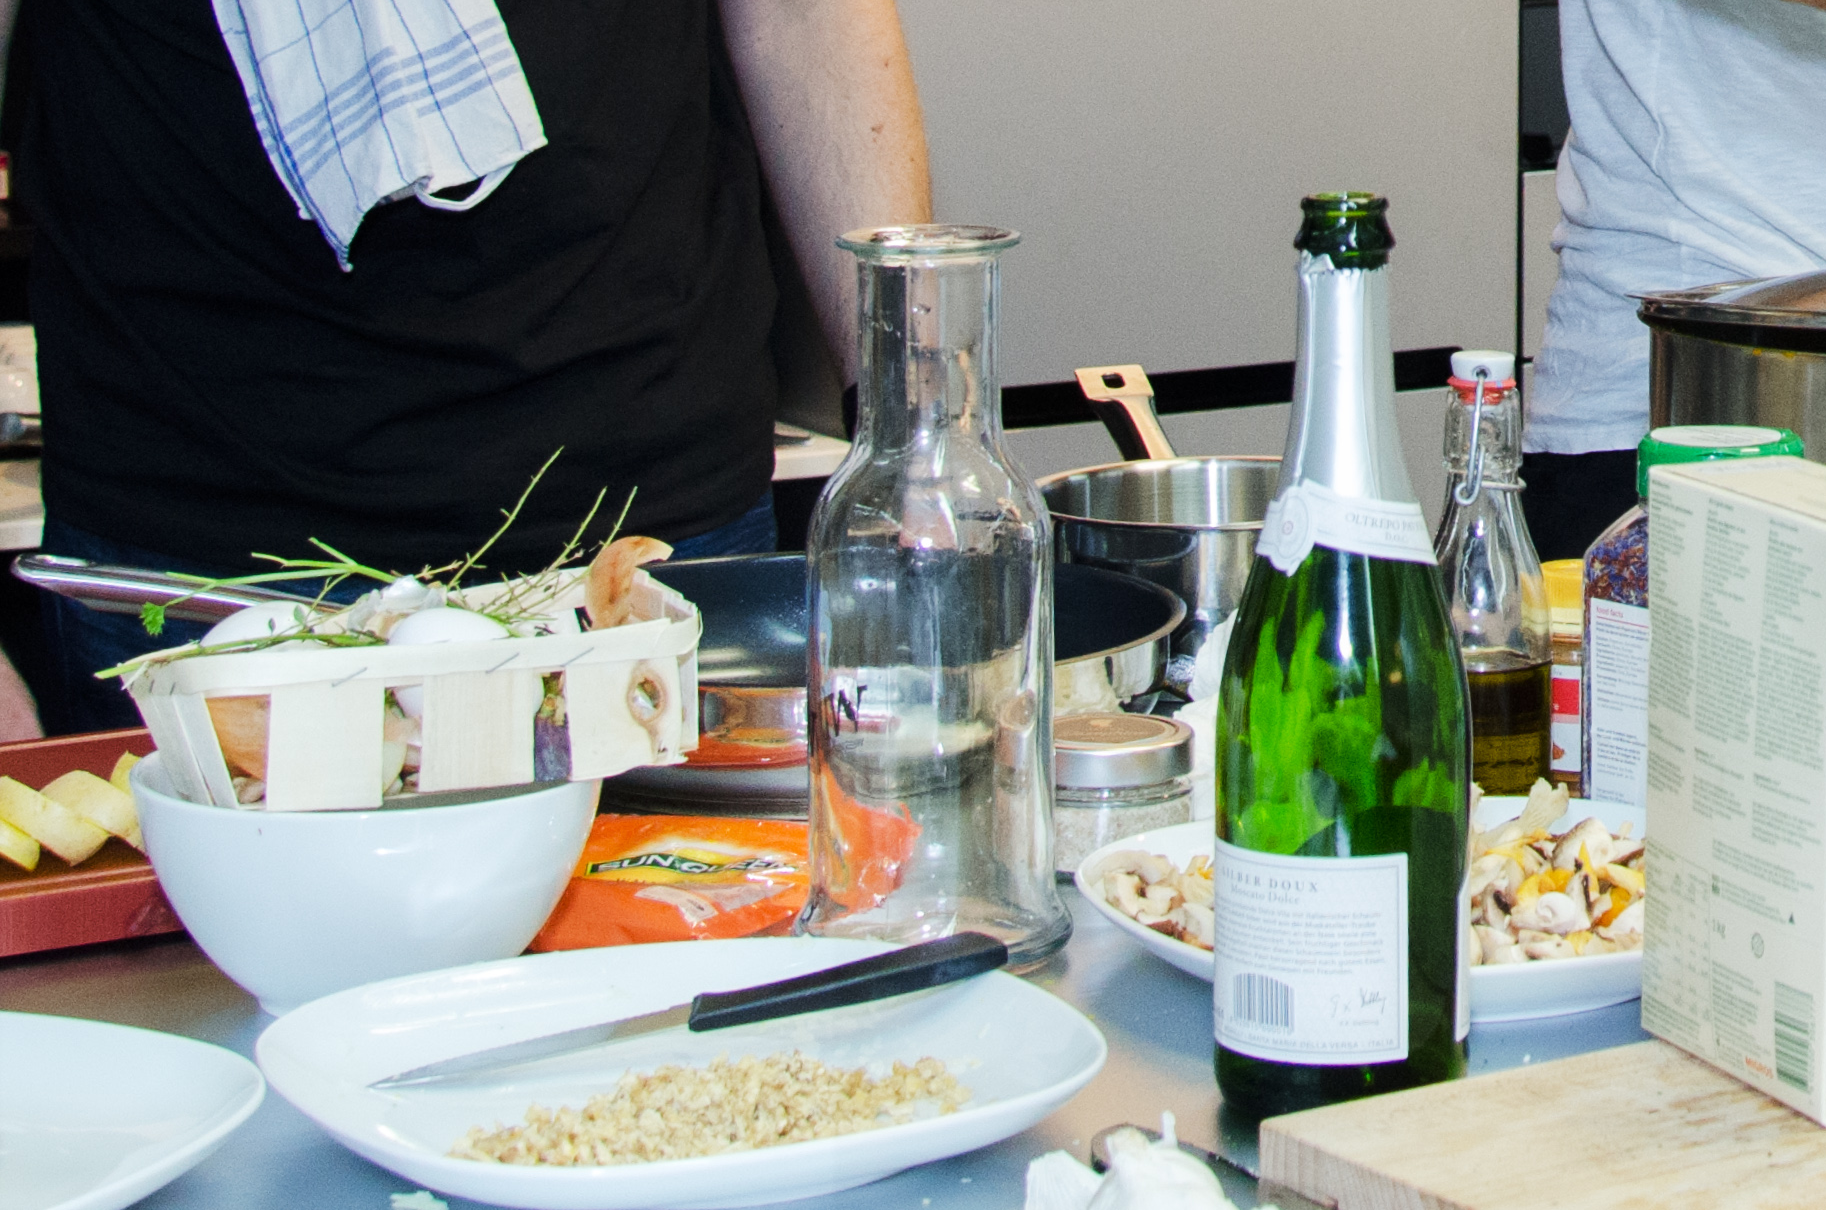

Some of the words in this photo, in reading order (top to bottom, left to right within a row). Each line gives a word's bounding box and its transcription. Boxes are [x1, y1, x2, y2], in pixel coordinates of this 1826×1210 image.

[598, 853, 676, 873] SUN
[1268, 877, 1320, 894] DOUX
[1268, 890, 1300, 906] Dolce
